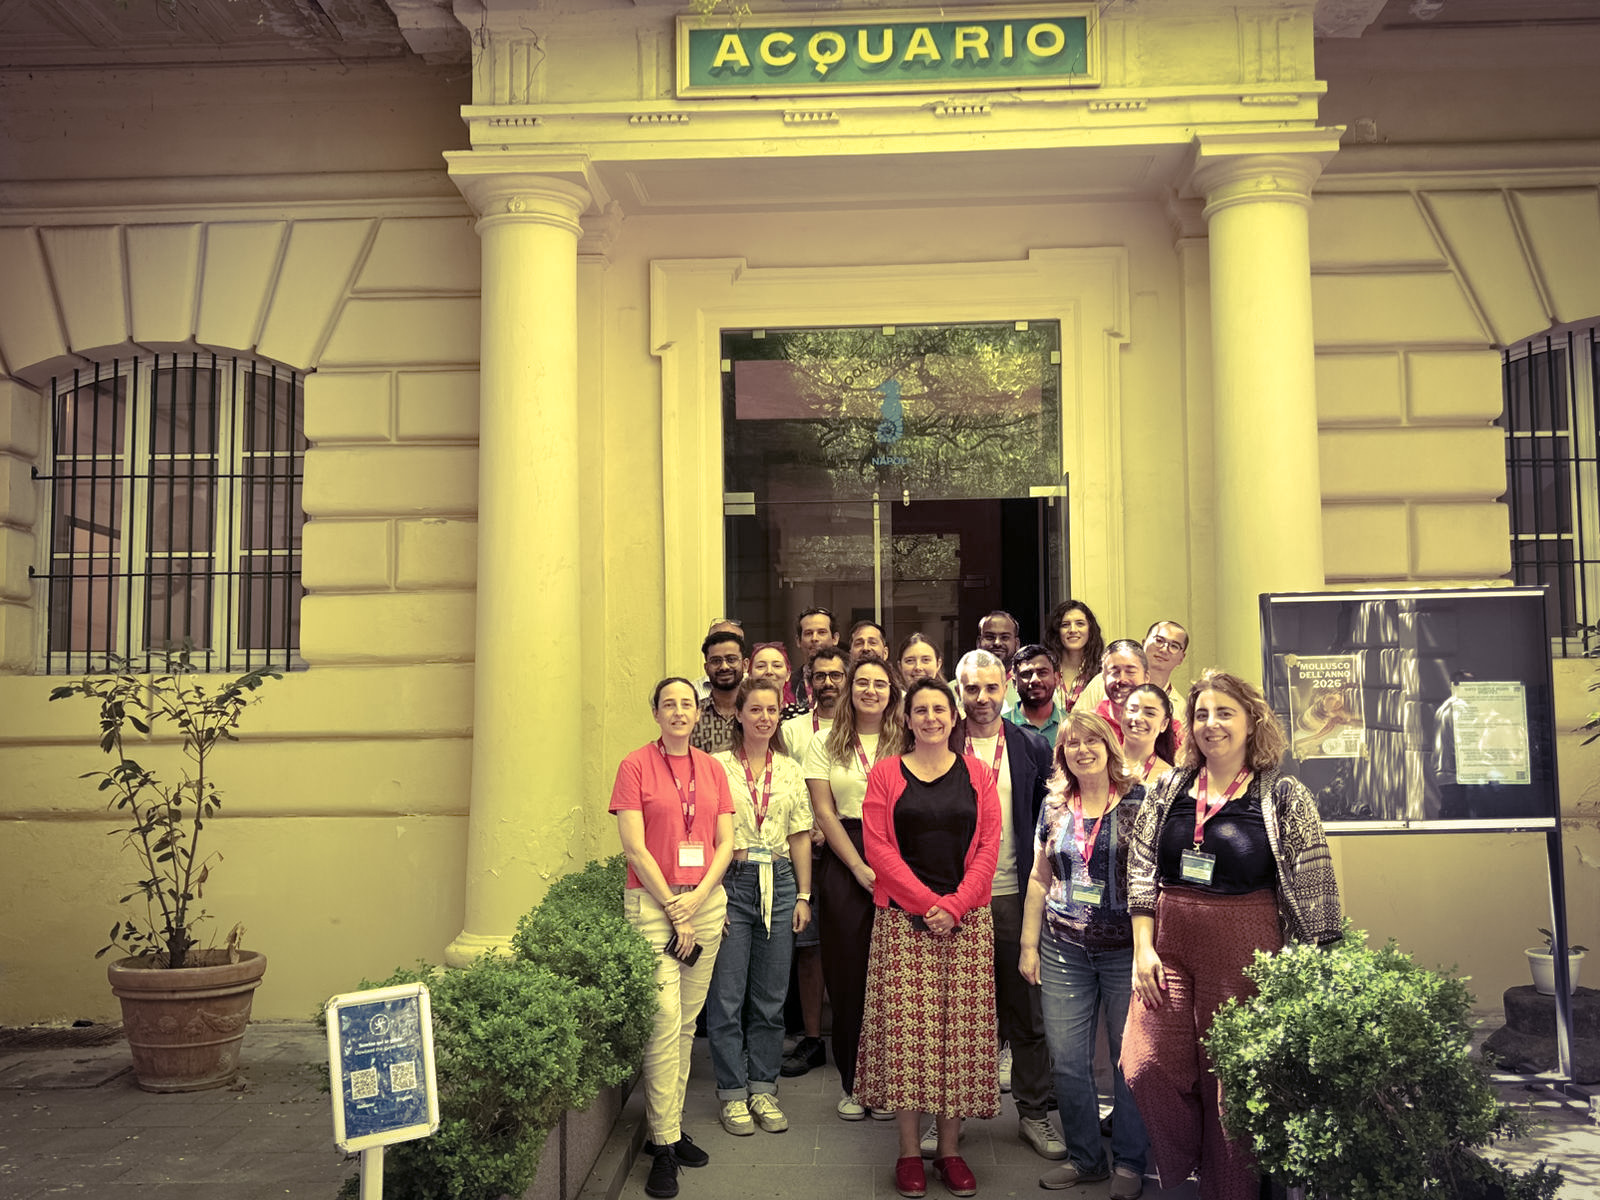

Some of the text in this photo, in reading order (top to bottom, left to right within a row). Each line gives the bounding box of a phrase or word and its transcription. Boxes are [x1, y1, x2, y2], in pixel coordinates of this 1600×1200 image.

[713, 23, 1066, 75] ACQUARIO
[1300, 662, 1350, 670] MOLLUSCO
[1299, 670, 1350, 679] DELL'ANNO
[1312, 679, 1342, 688] 2026
